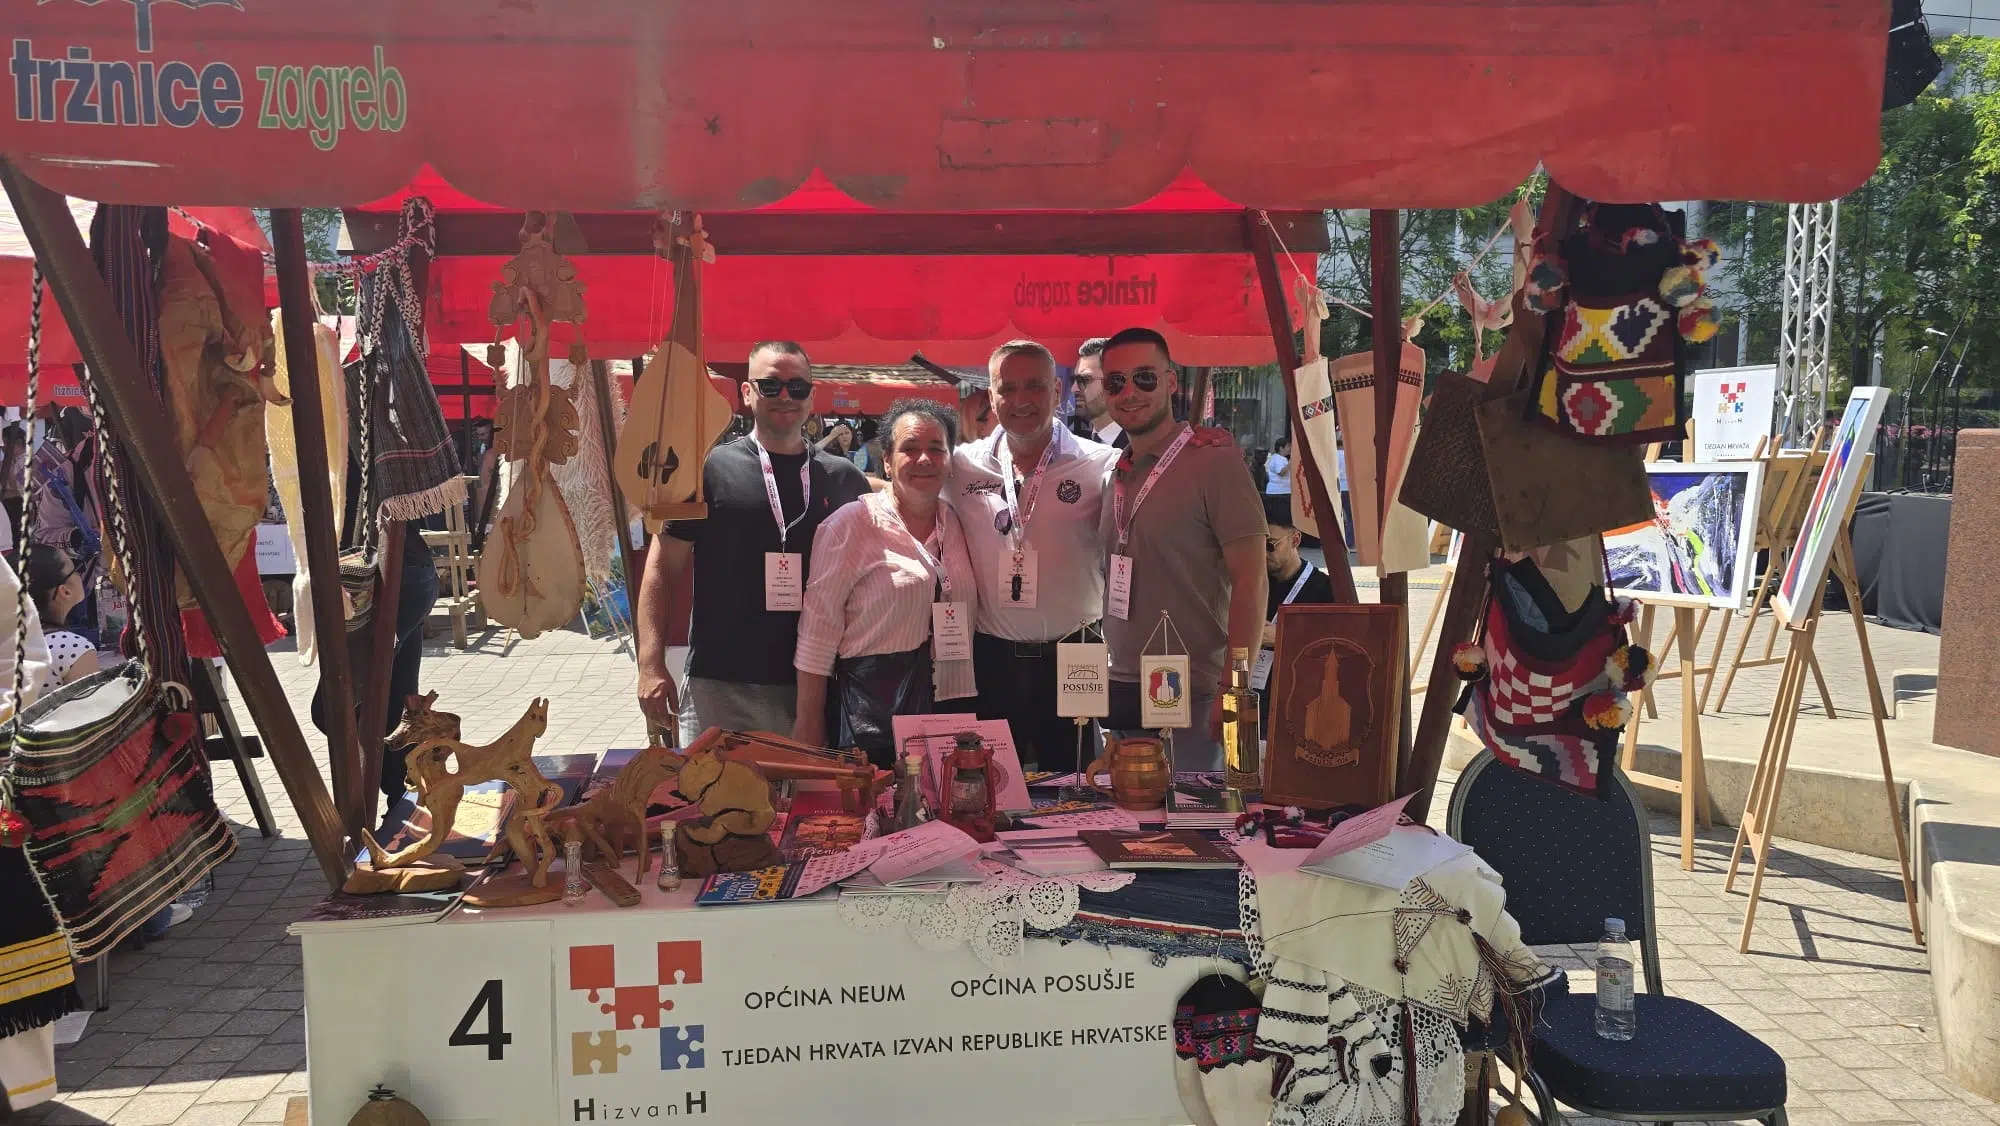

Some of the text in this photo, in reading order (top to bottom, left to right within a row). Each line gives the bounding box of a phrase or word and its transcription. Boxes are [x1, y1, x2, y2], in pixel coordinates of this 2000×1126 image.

[256, 45, 407, 150] zagreb
[1063, 682, 1104, 692] POSUŠJE
[745, 983, 906, 1009] OPĆINA NEUM
[951, 967, 1135, 997] OPĆINA POSUŠJE
[449, 979, 512, 1060] 4
[722, 1024, 1167, 1066] TJEDAN HRVATA IZVAN REPUBLIKE HRVATSKE
